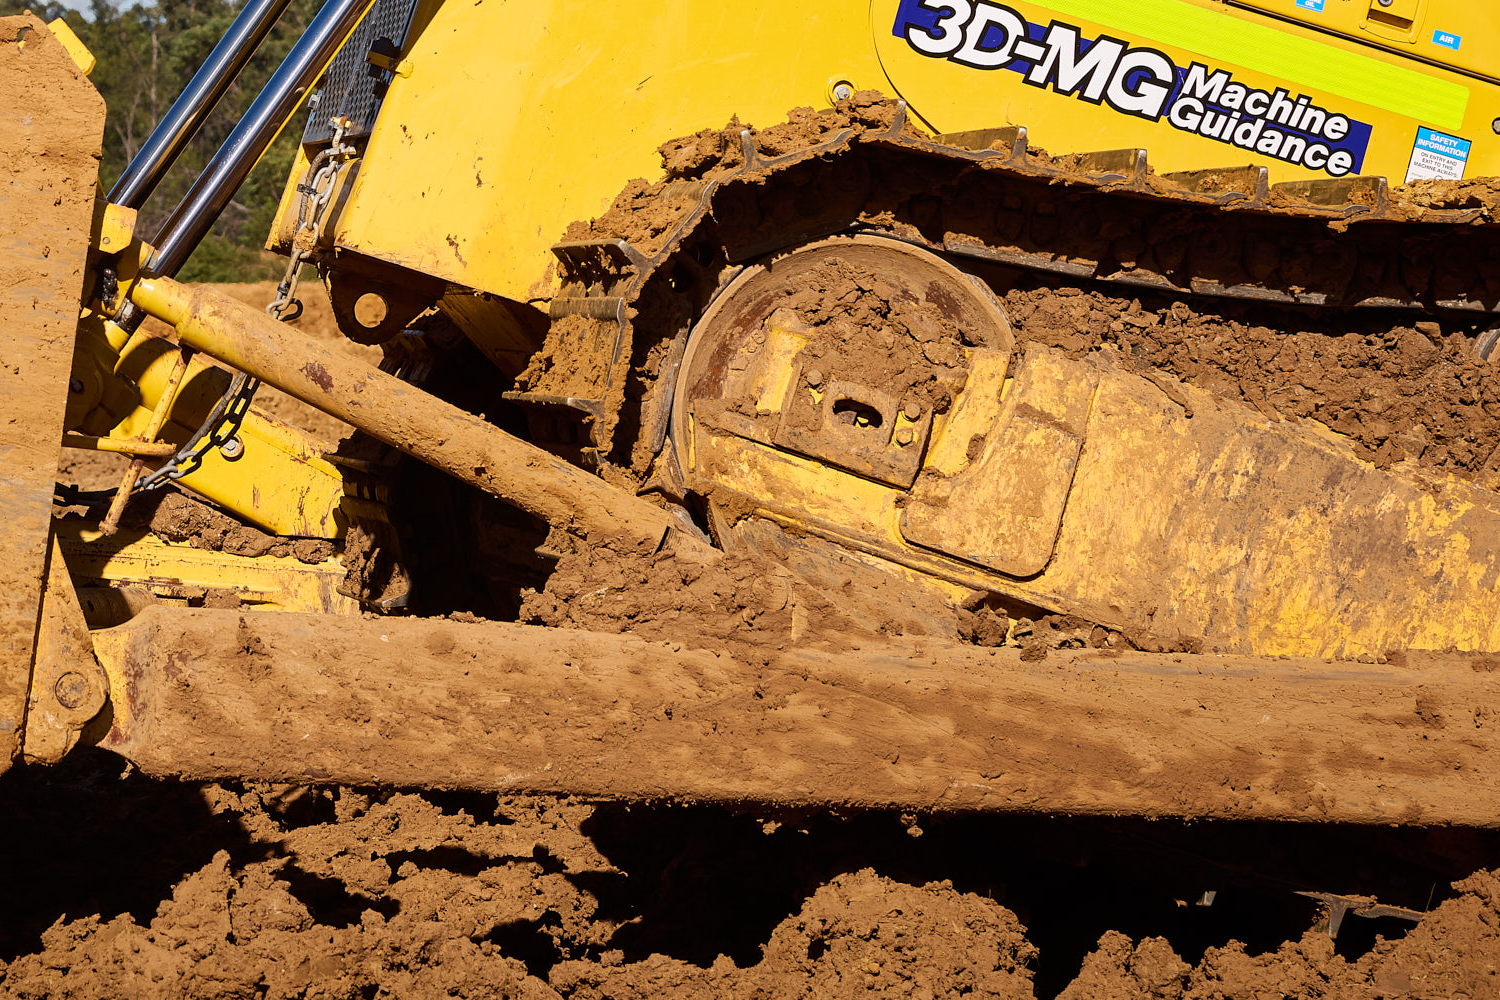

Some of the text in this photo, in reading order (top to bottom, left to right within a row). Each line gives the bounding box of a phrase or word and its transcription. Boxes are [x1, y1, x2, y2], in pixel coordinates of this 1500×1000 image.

[1305, 0, 1315, 8] OIL
[1439, 35, 1454, 44] AIR
[1181, 63, 1350, 141] Machine
[1168, 95, 1353, 176] Guidance
[1430, 134, 1458, 147] SAFETY
[1418, 139, 1466, 157] INFORMATION
[1422, 157, 1433, 165] EXIT
[1442, 163, 1453, 171] THIS
[1430, 154, 1446, 162] ENTRY
[1414, 161, 1435, 171] MACHINE
